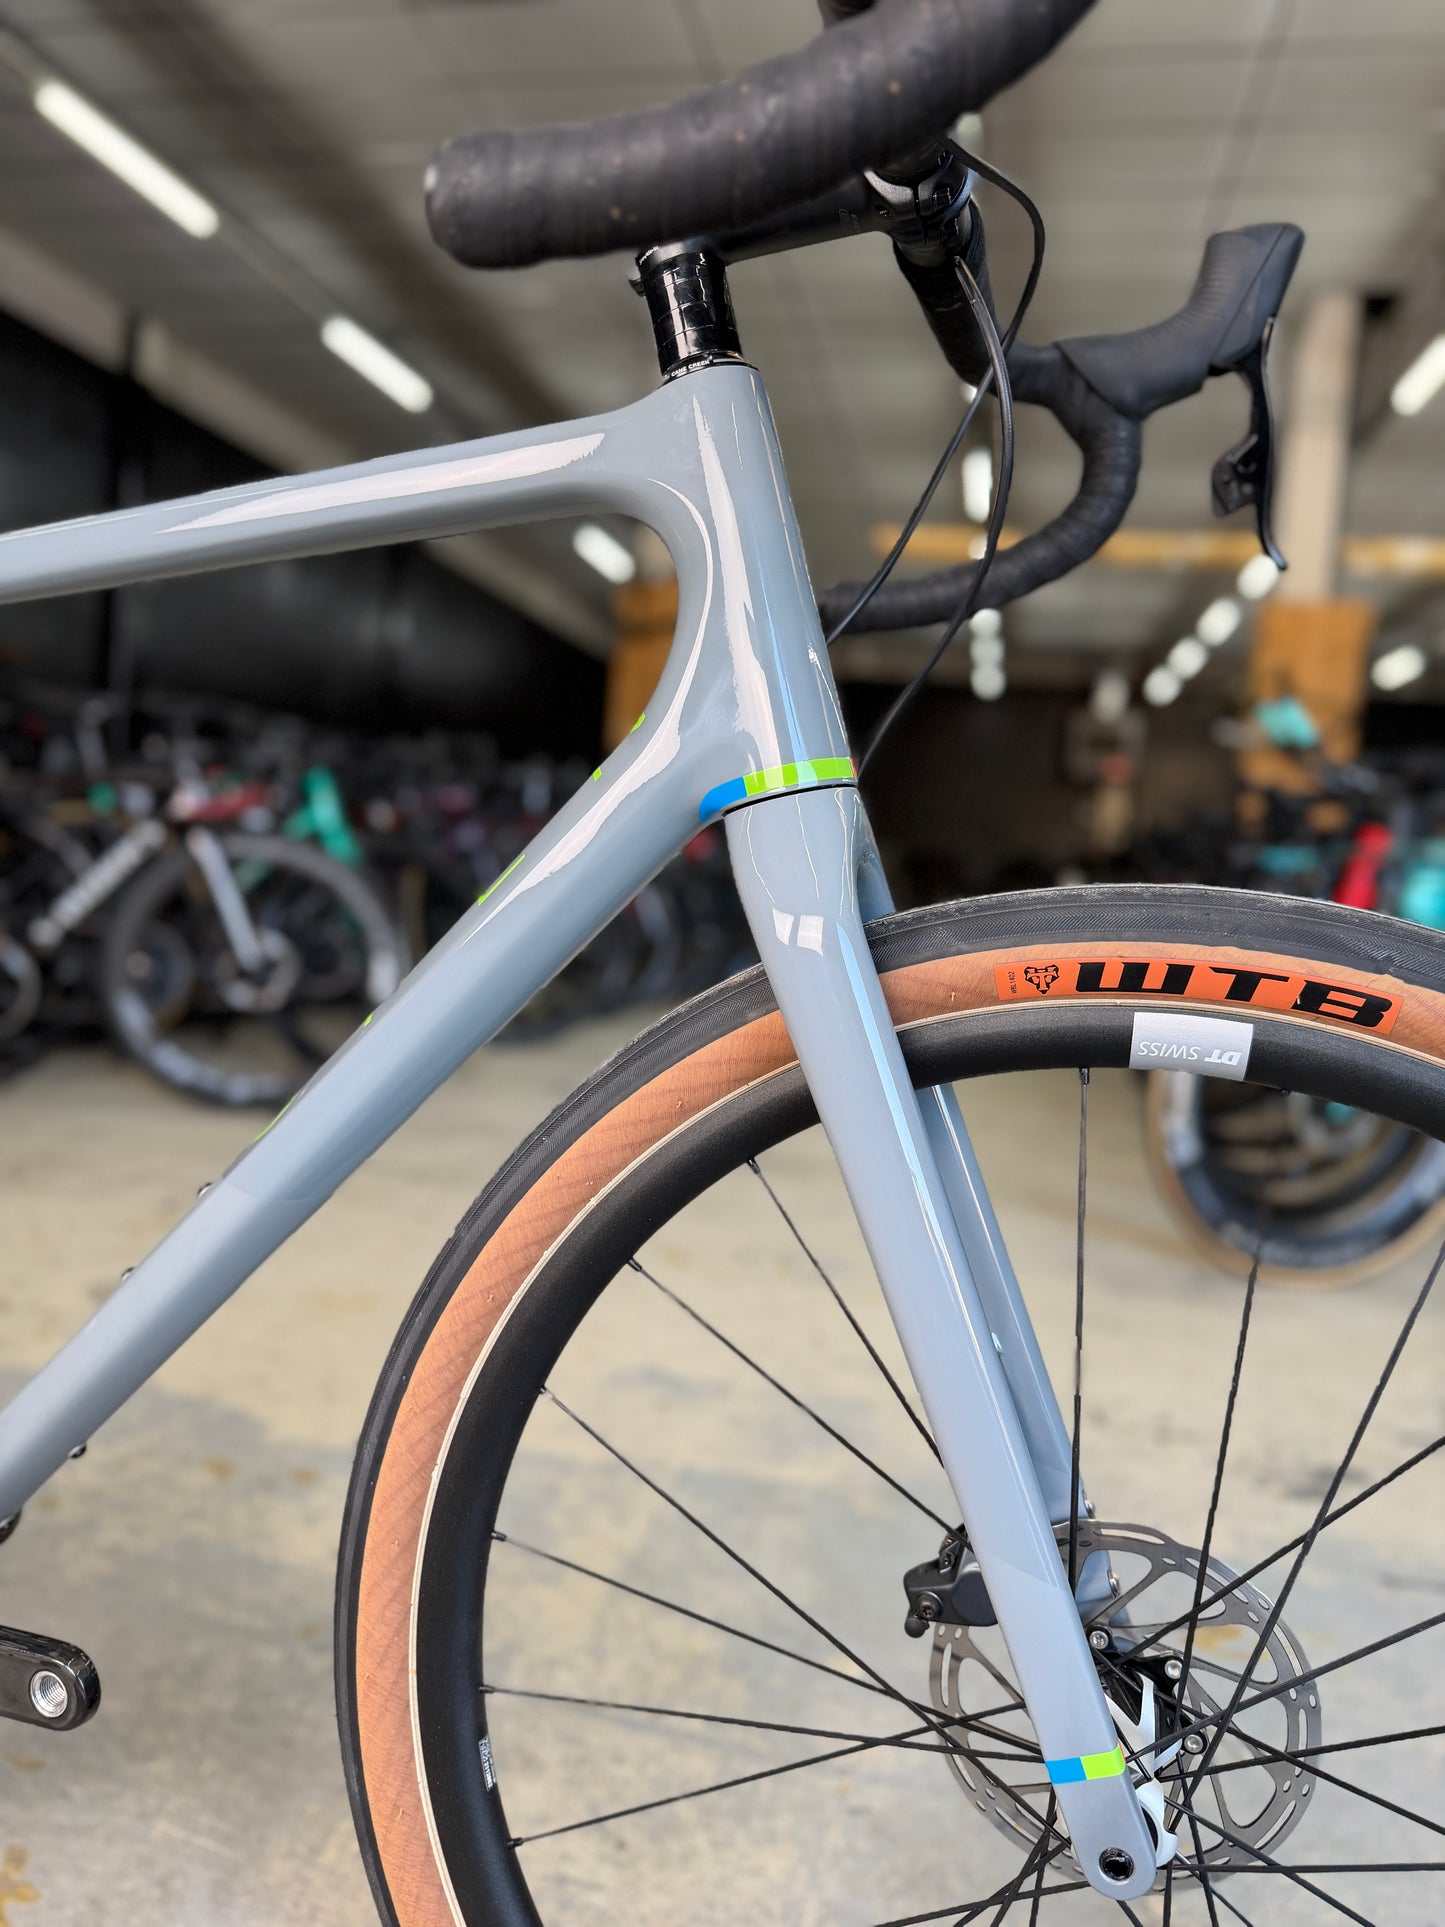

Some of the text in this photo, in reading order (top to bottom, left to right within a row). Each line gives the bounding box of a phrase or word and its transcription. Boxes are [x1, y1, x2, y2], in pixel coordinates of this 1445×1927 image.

[671, 359, 710, 377] CANE CREEK
[1075, 962, 1393, 1028] WTB
[1138, 1041, 1242, 1066] DT SWISS
